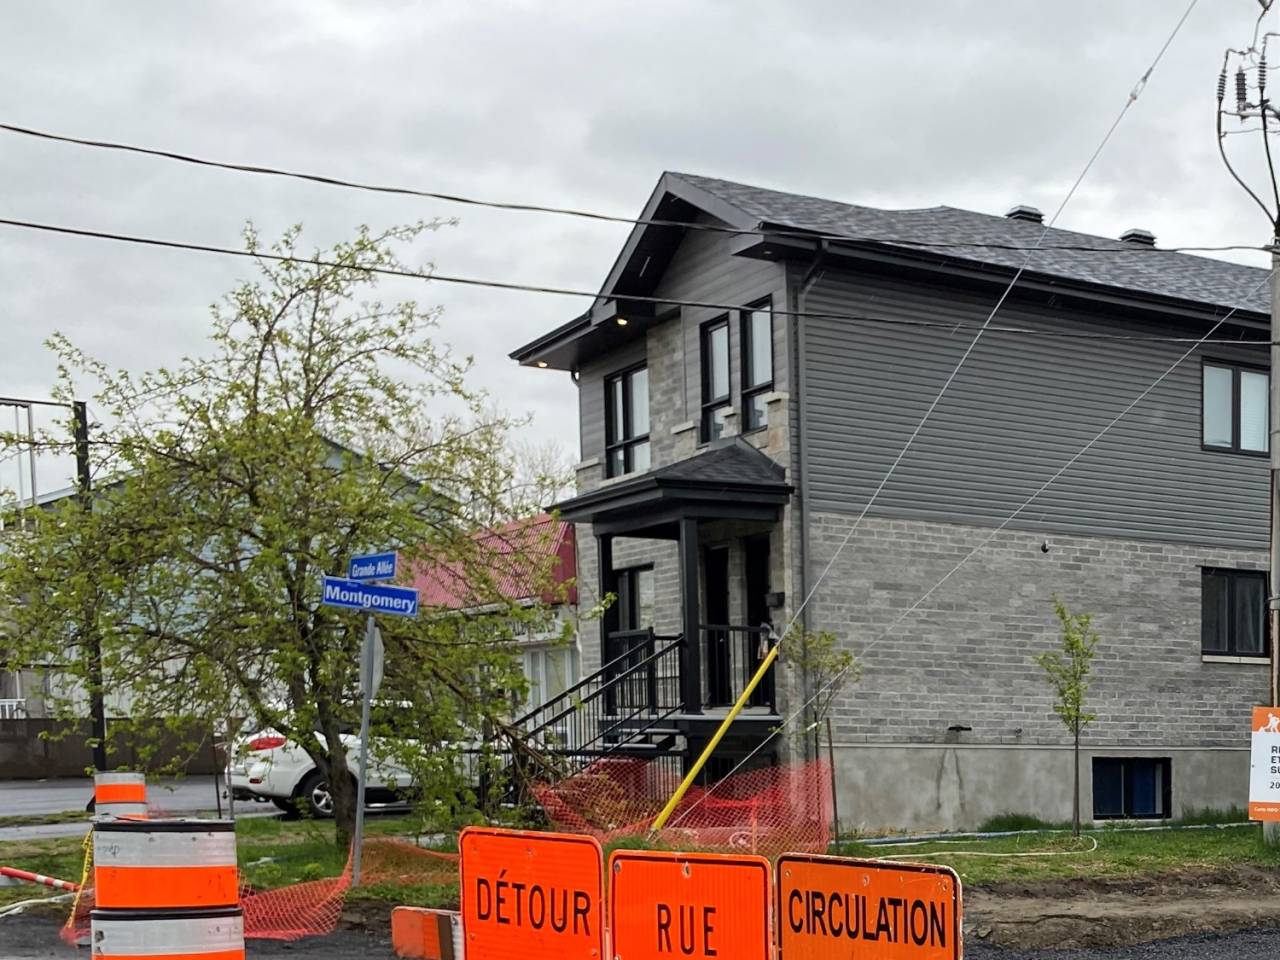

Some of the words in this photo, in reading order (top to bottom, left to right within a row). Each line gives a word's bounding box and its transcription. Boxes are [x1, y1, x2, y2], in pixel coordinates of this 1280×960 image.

[352, 563, 376, 577] Grande
[325, 585, 414, 613] Montgomery
[476, 868, 591, 937] DÉTOUR
[788, 888, 947, 948] CIRCULATION
[656, 903, 718, 958] RUE
